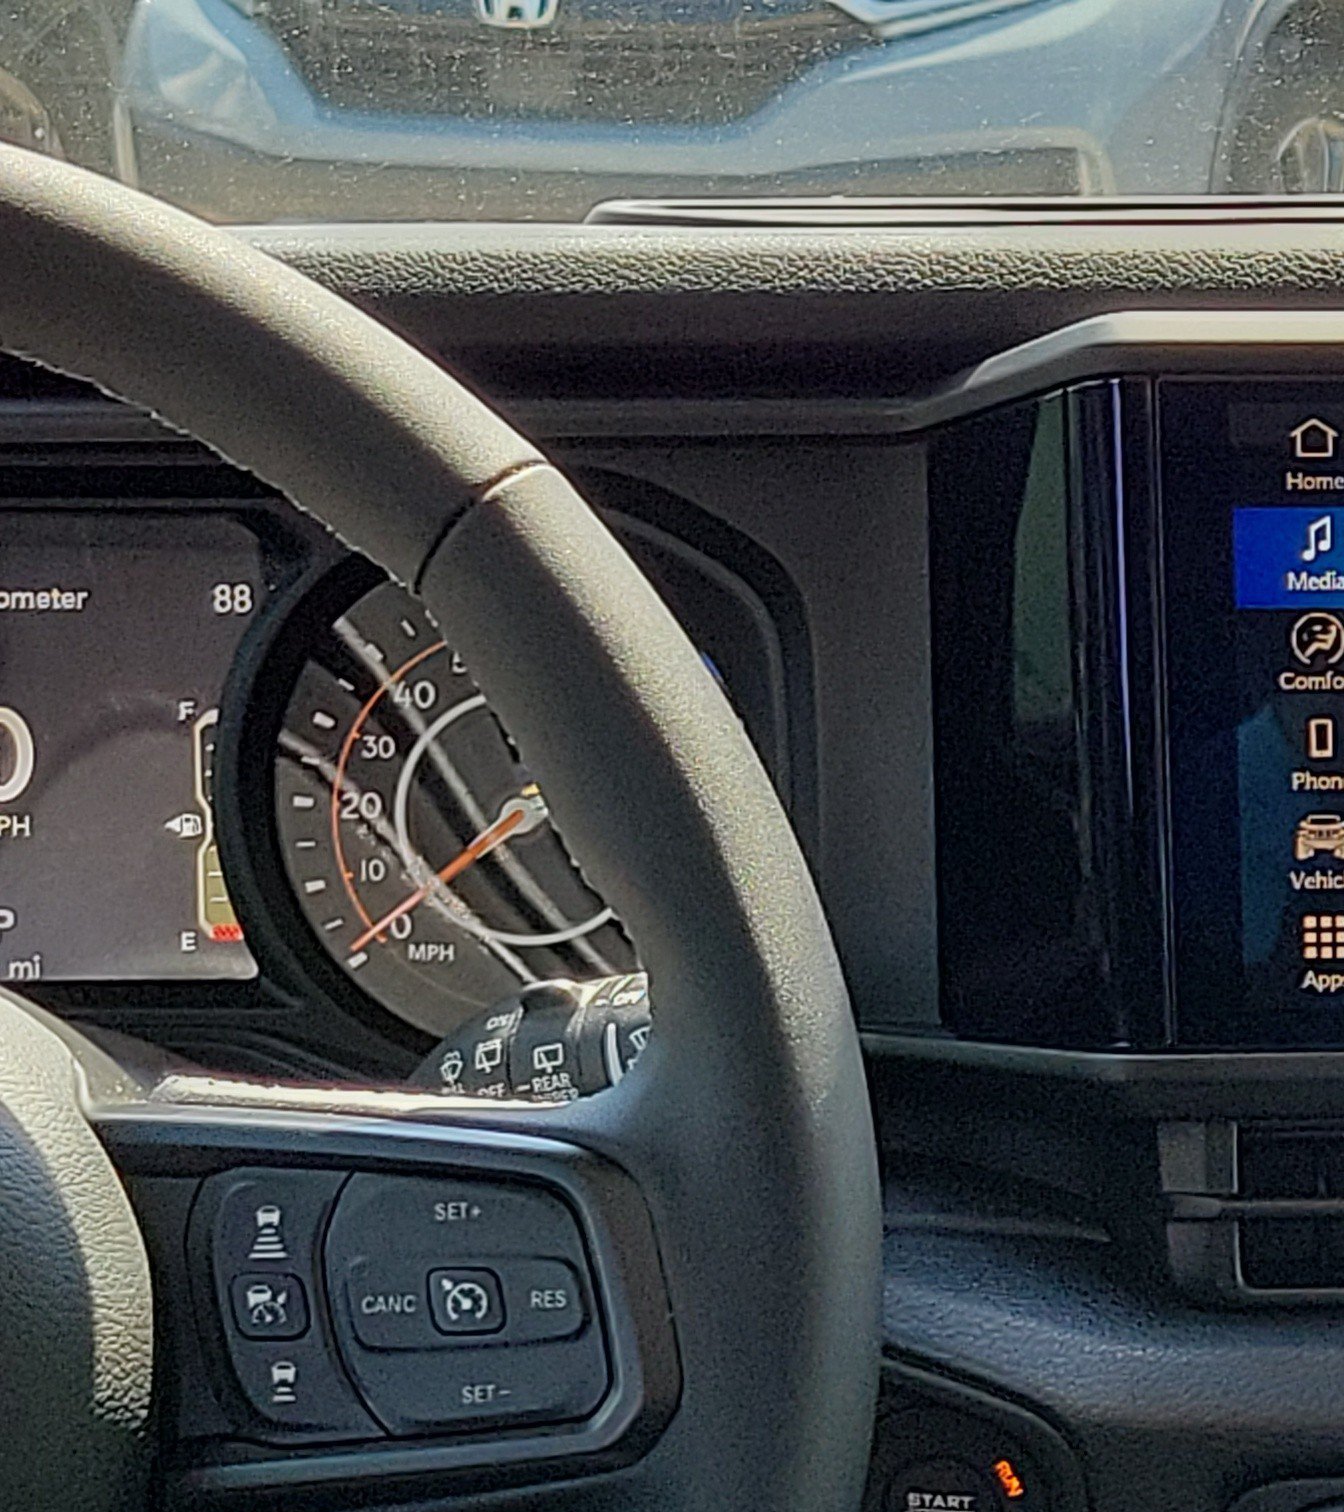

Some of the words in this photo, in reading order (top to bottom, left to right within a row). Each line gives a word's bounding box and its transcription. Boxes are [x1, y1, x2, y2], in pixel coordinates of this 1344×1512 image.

[1286, 471, 1344, 491] Home
[213, 583, 252, 614] 88
[393, 680, 436, 709] 40
[178, 701, 195, 721] F
[361, 736, 396, 759] 30
[341, 792, 382, 820] 20
[360, 859, 386, 882] 10
[181, 931, 197, 951] E
[408, 943, 455, 961] MPH
[8, 954, 42, 979] mi
[531, 1072, 571, 1093] REAR
[361, 1294, 417, 1314] CANC
[530, 1289, 567, 1309] RES
[907, 1492, 976, 1510] START
